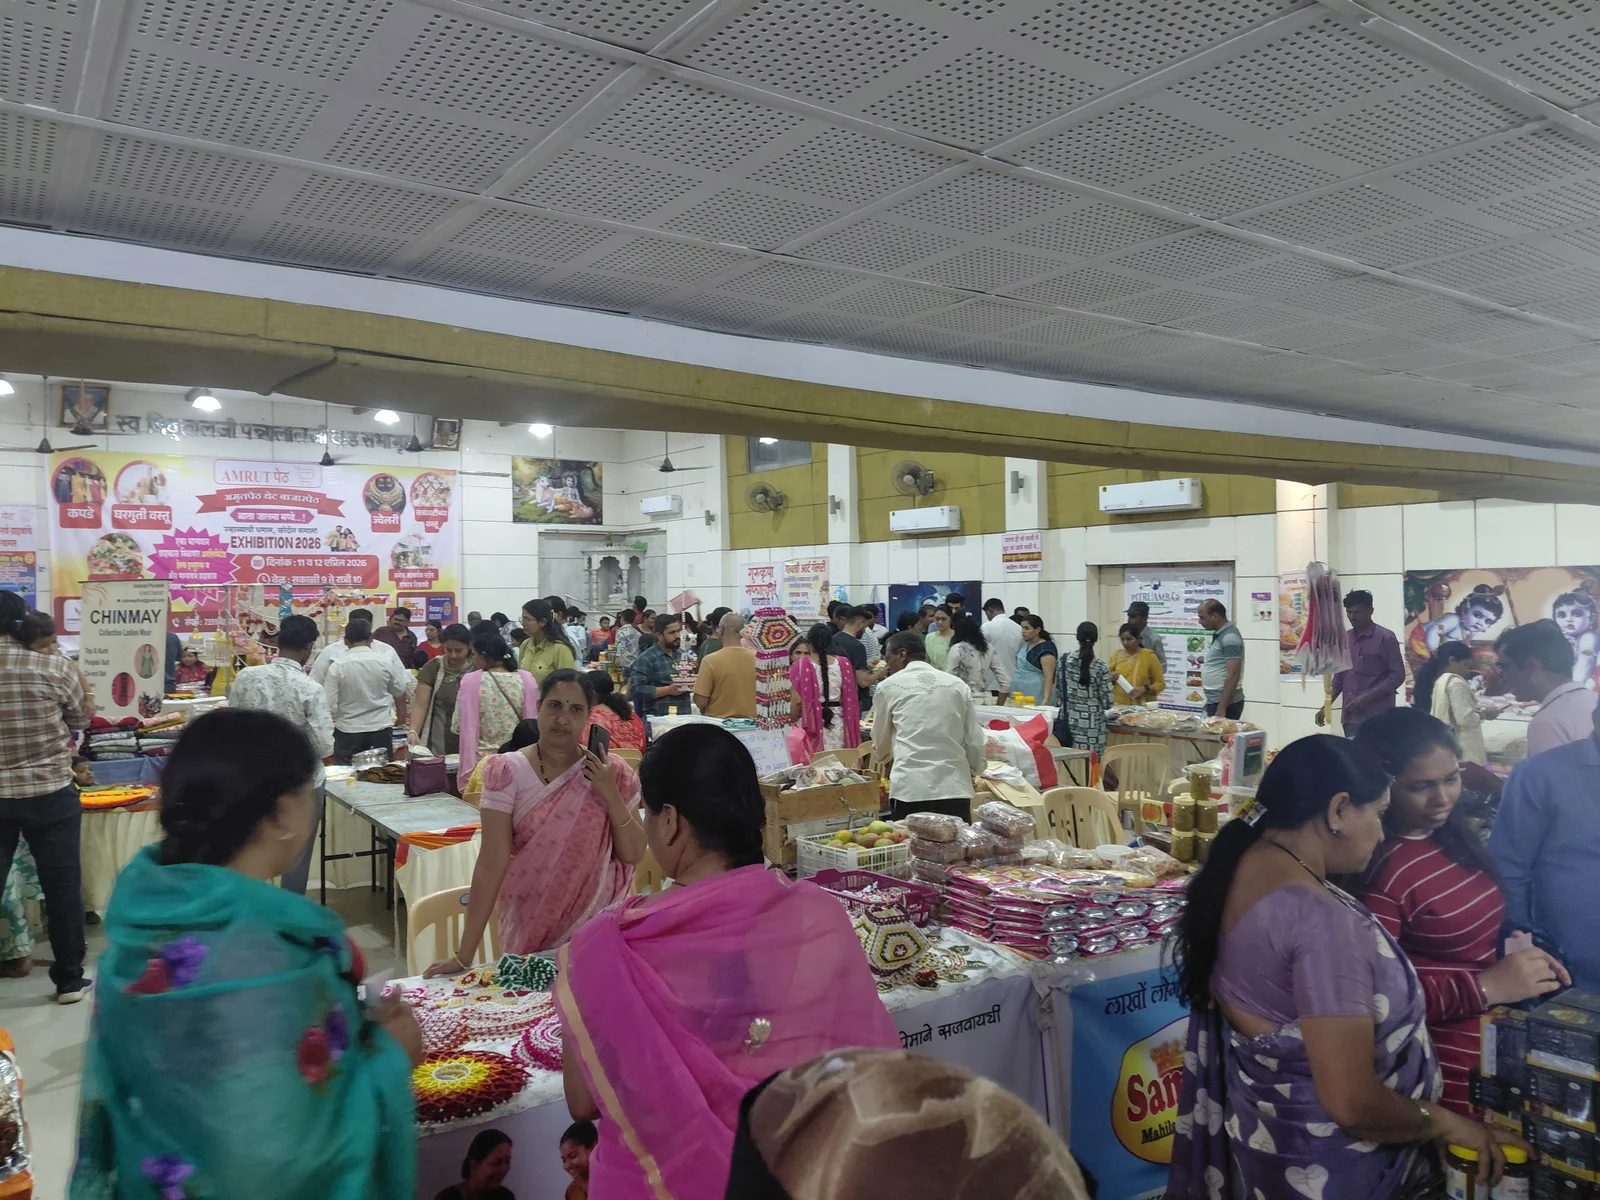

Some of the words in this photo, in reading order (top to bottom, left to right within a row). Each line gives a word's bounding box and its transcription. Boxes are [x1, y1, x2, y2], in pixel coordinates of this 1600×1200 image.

[222, 469, 271, 483] AMRUT
[273, 467, 290, 483] पेठ
[67, 506, 95, 519] कपडे
[113, 507, 147, 524] घरगुती
[148, 509, 171, 525] वस्तू
[372, 513, 399, 525] ज्वेलरी
[230, 535, 294, 549] EXHIBITION
[295, 538, 321, 549] 2026
[266, 556, 292, 568] दिनांक
[314, 559, 323, 567] 12
[346, 559, 367, 567] 2026
[800, 560, 811, 573] आर्ट
[90, 609, 161, 624] CHINMAY
[98, 628, 122, 636] Collection
[123, 628, 139, 636] Ladies
[139, 628, 152, 636] Wear
[1104, 981, 1147, 1015] लाखों
[1151, 976, 1182, 1004] लोग
[937, 1004, 1001, 1041] सजवायची
